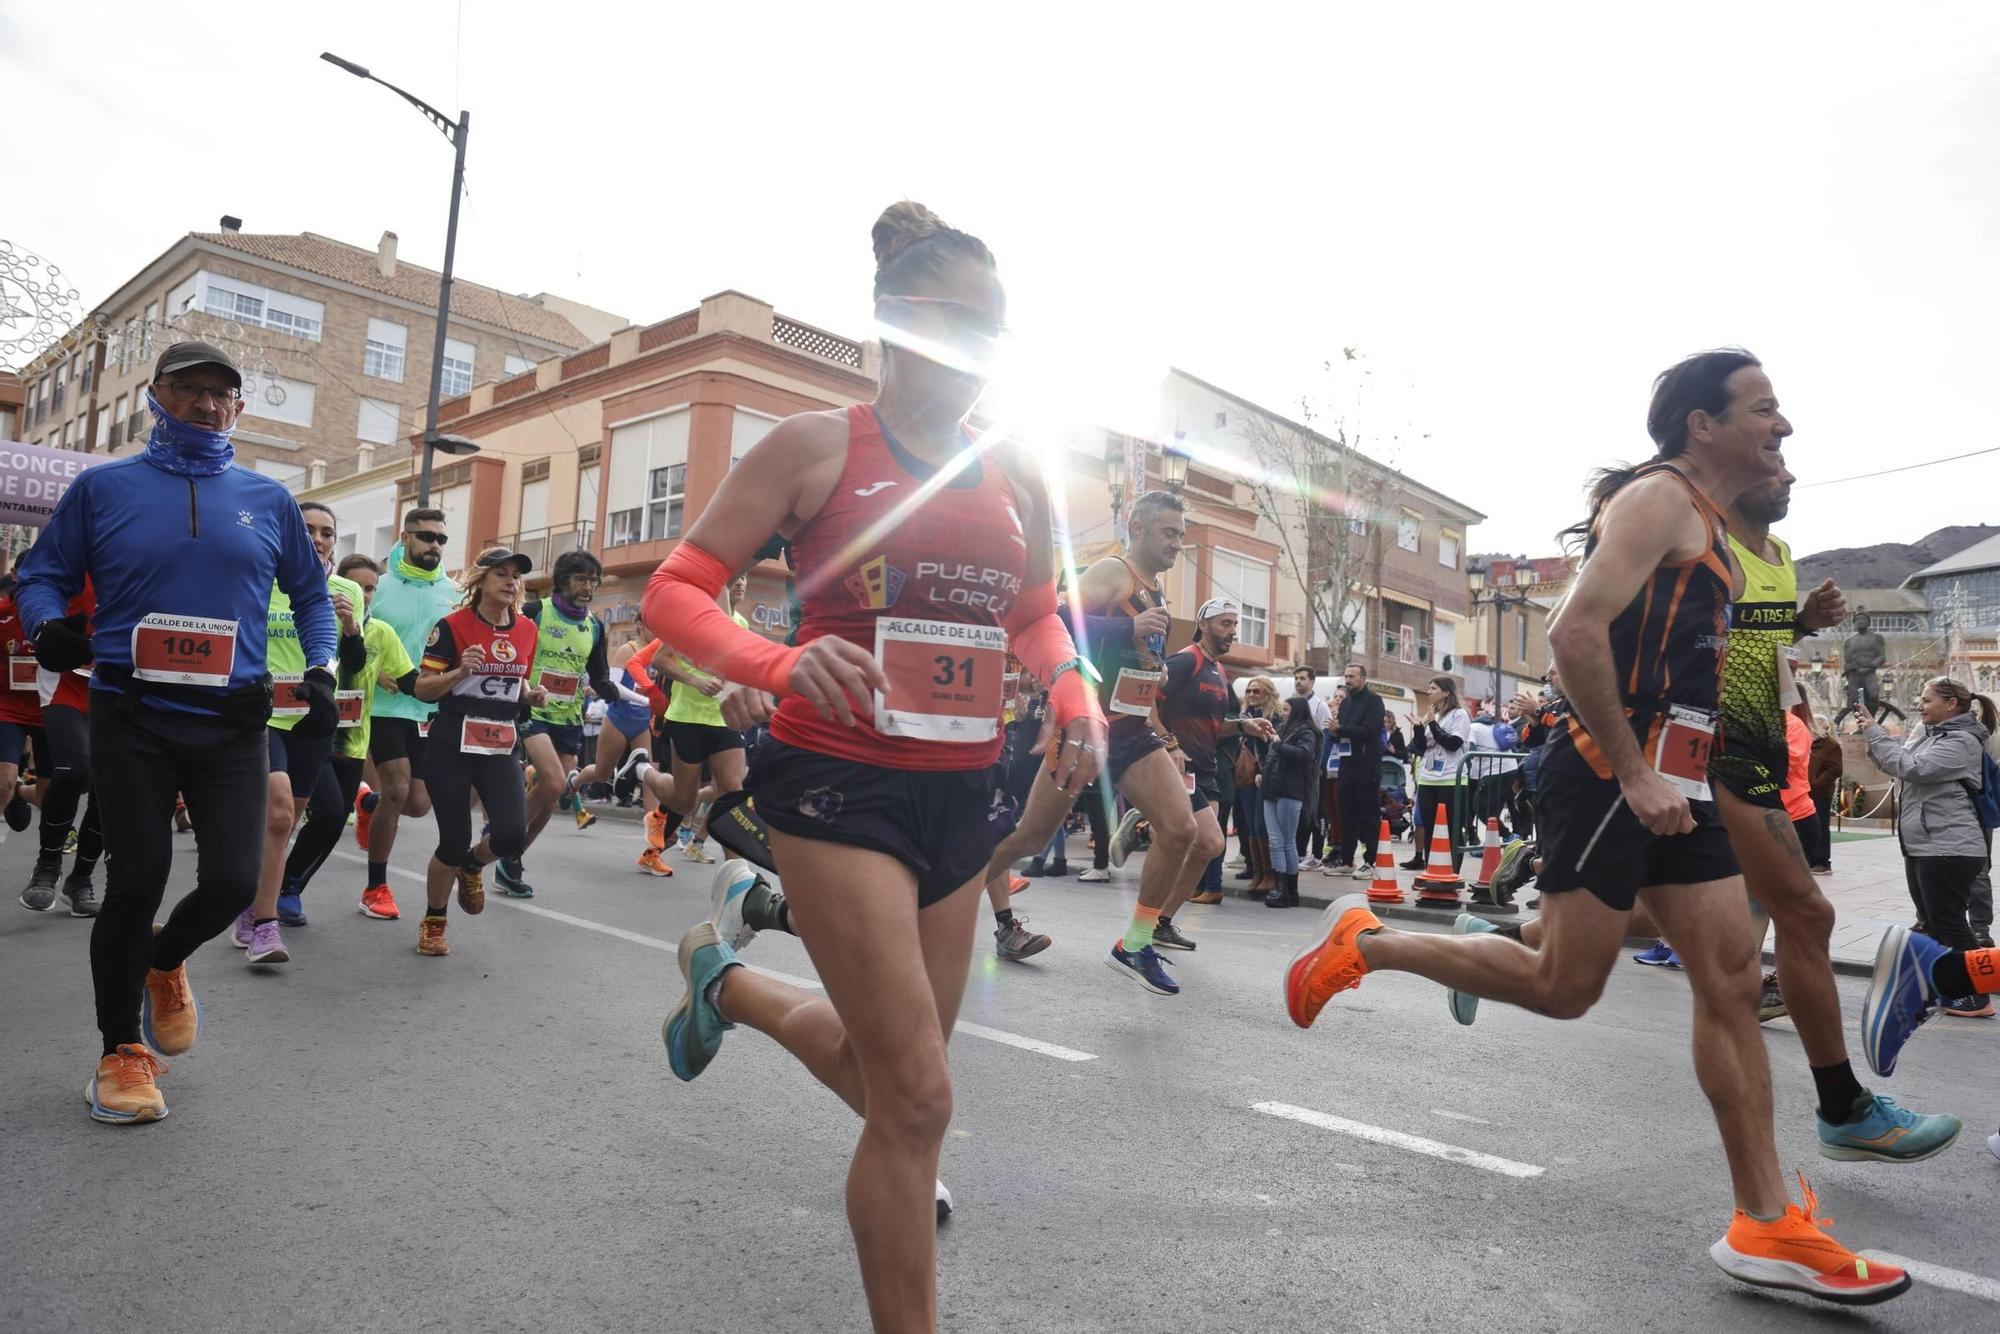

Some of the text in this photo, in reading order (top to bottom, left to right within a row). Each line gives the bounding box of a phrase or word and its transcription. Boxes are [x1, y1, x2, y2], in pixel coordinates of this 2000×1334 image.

[142, 617, 180, 627] ALCALDE
[182, 620, 194, 629] DE
[208, 622, 234, 632] UNIÓN
[281, 612, 293, 621] CR
[887, 621, 1004, 642] ALCALDE DE LA UNI
[163, 637, 212, 657] 104
[933, 655, 975, 688] 31
[480, 676, 520, 696] CT
[1136, 682, 1151, 696] 17
[485, 727, 500, 738] 14
